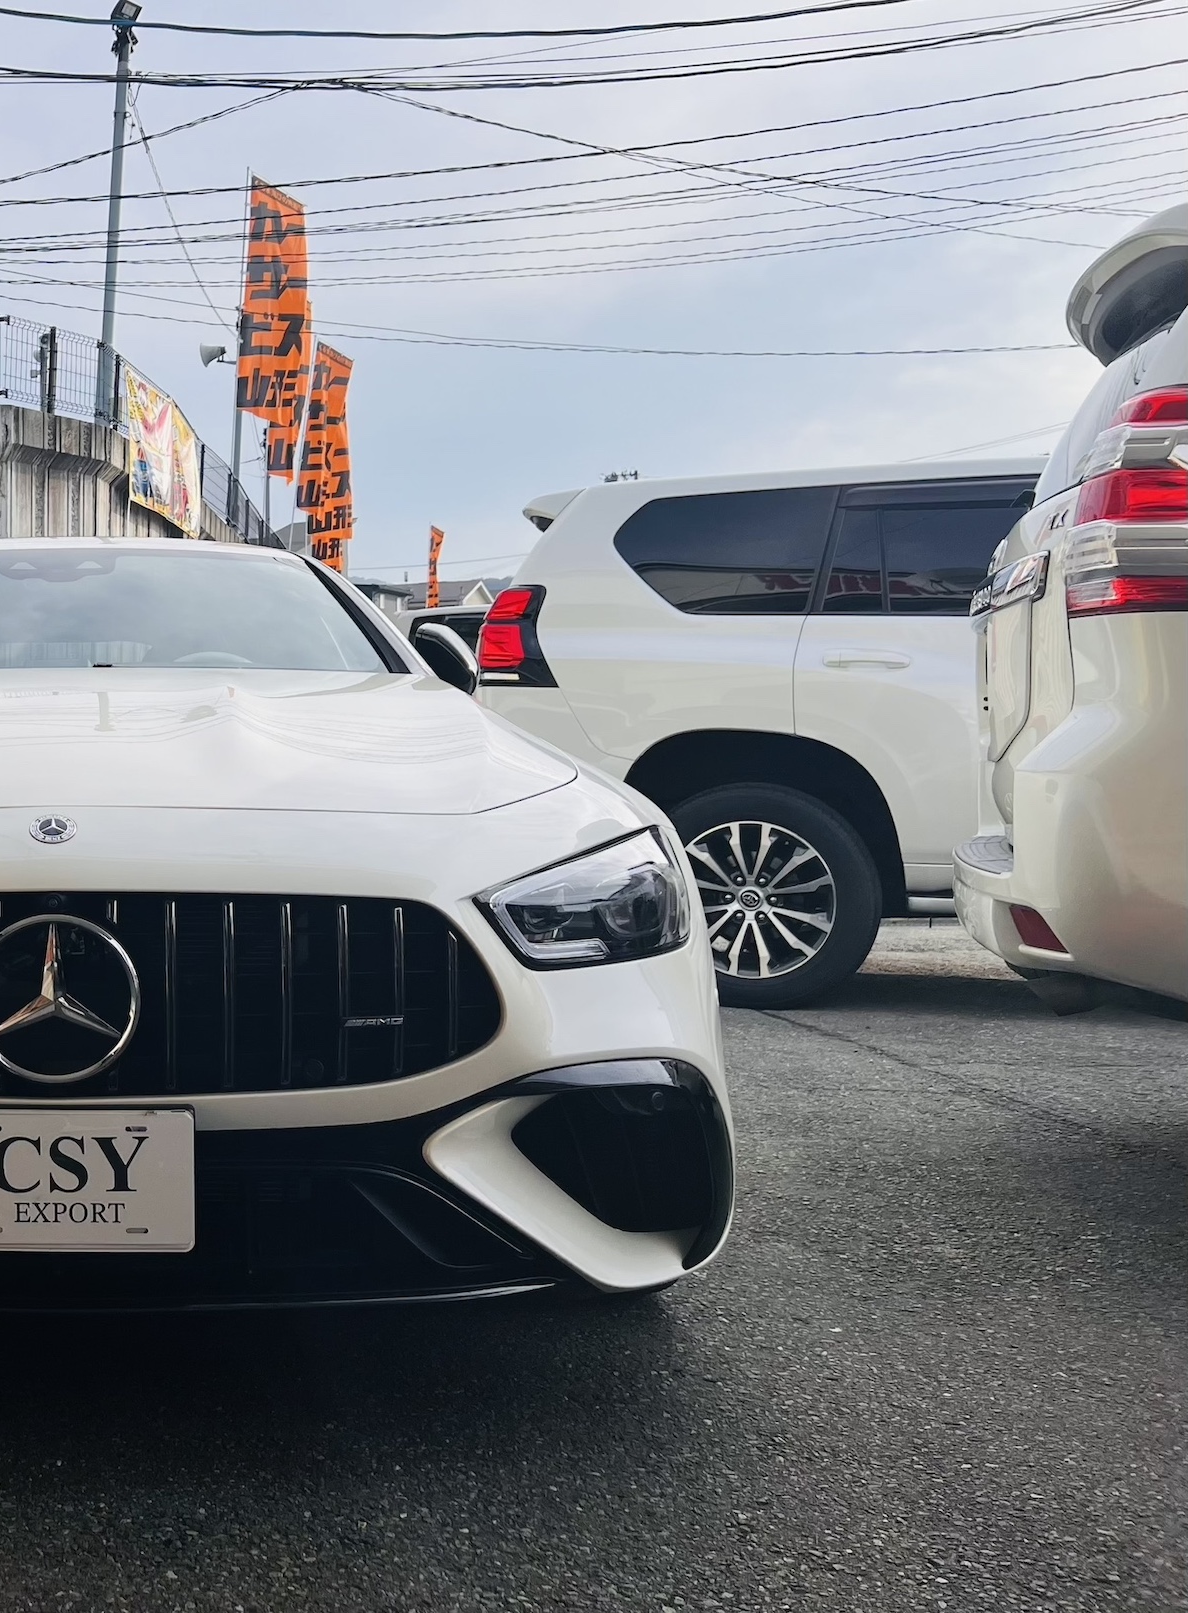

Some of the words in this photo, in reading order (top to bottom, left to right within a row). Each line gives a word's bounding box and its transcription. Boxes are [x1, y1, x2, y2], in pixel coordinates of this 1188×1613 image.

[249, 201, 305, 244] カー
[240, 312, 305, 357] ビス
[14, 1202, 126, 1224] EXPORT
